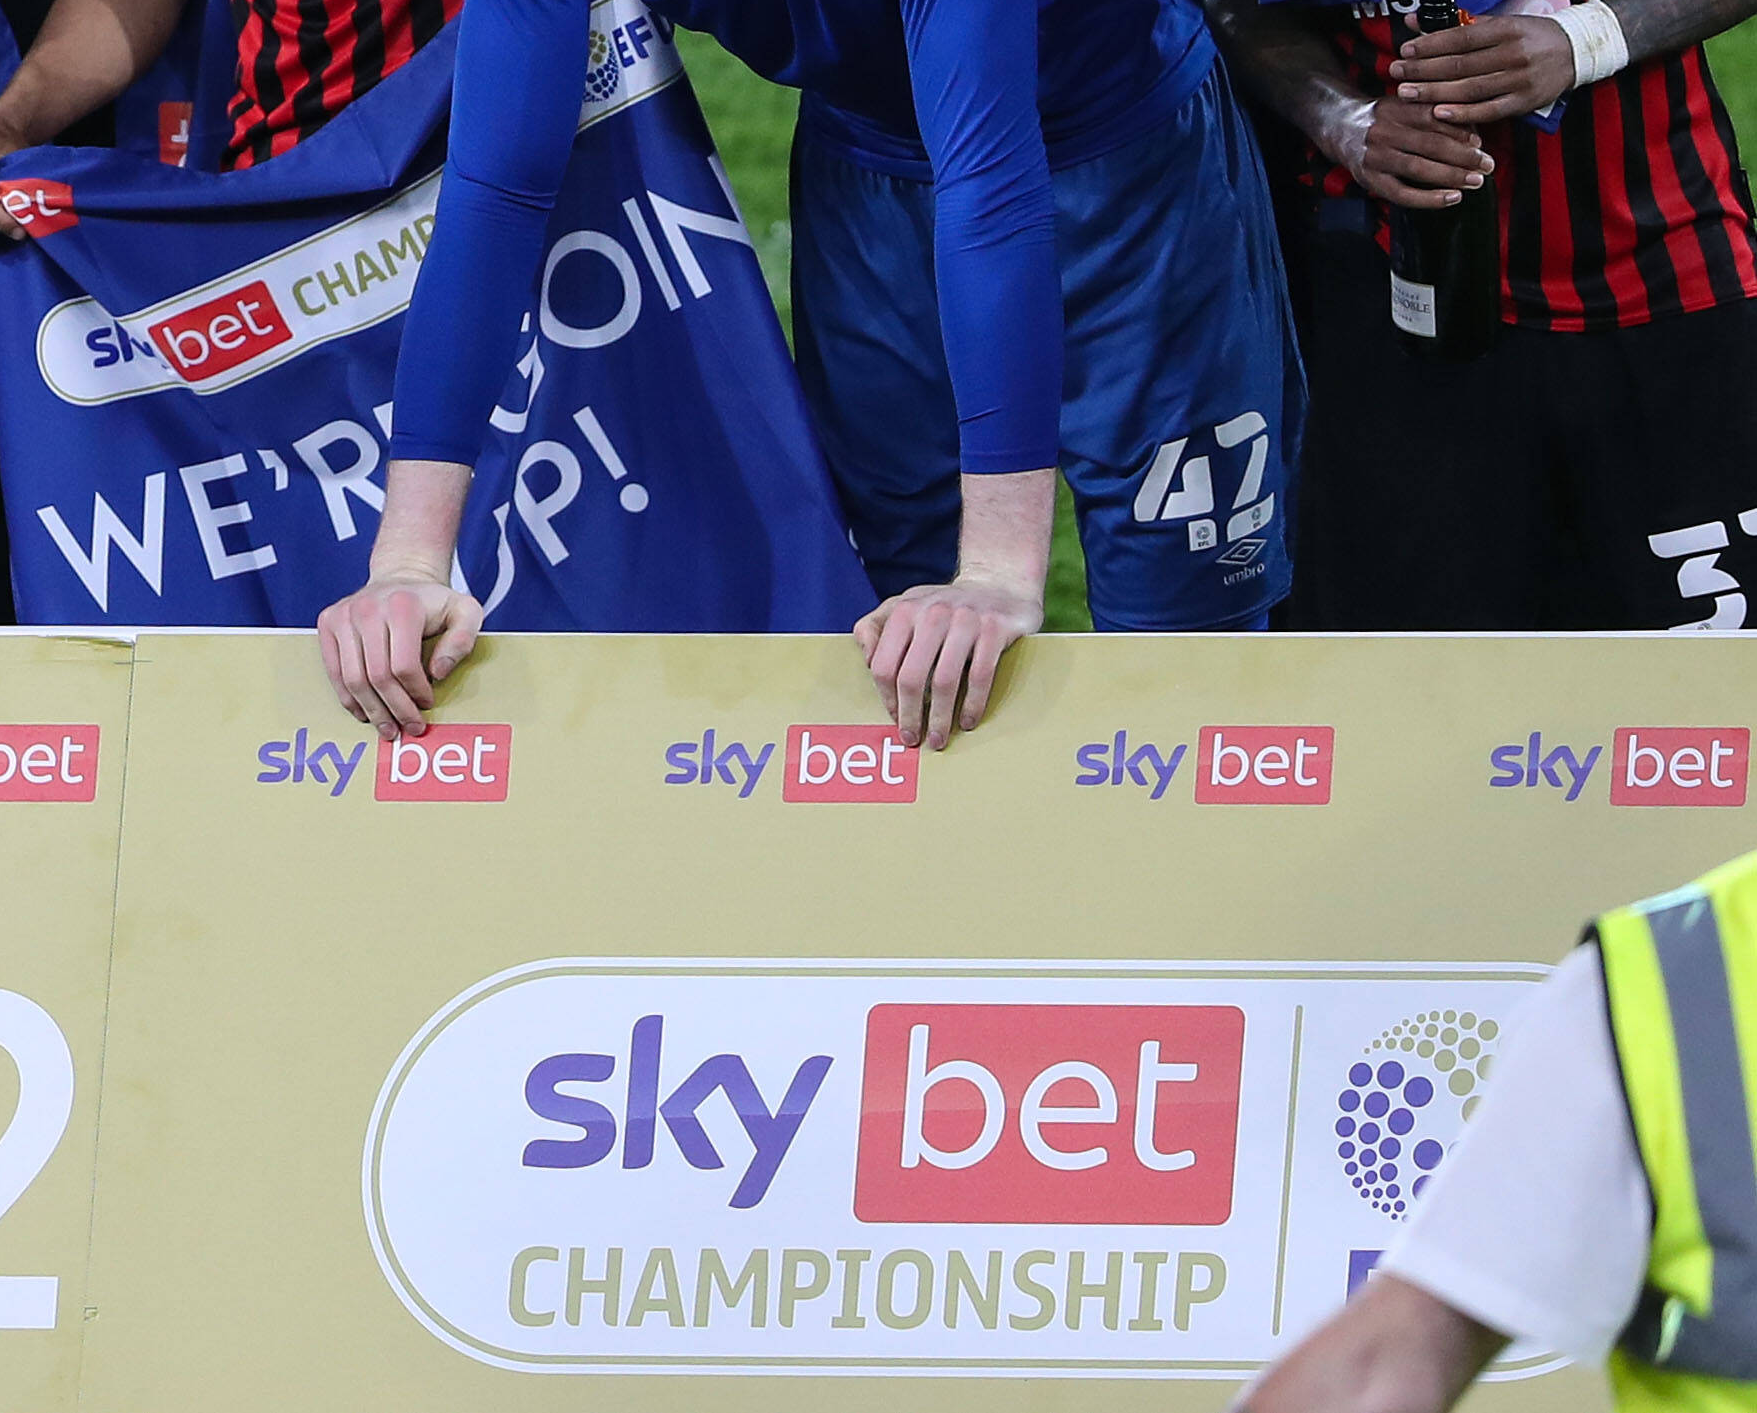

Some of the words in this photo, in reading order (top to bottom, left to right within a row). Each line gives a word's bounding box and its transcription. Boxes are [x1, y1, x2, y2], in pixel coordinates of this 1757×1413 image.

[162, 298, 274, 370] bet
[291, 213, 438, 318] CHAMP
[36, 400, 394, 614] WE'R
[1132, 409, 1275, 553] 42
[1223, 563, 1265, 585] umbro
[1647, 507, 1757, 630] 3
[257, 727, 367, 796] sky
[389, 732, 497, 784] bet
[665, 728, 775, 798] sky
[798, 733, 905, 785] bet
[1076, 730, 1188, 799] sky
[1211, 732, 1319, 787] bet
[1490, 731, 1603, 801] sky
[1626, 734, 1734, 788] bet
[522, 1014, 834, 1210] sky
[900, 1023, 1199, 1172] bet
[507, 1244, 1228, 1334] CHAMPIONSHIP
